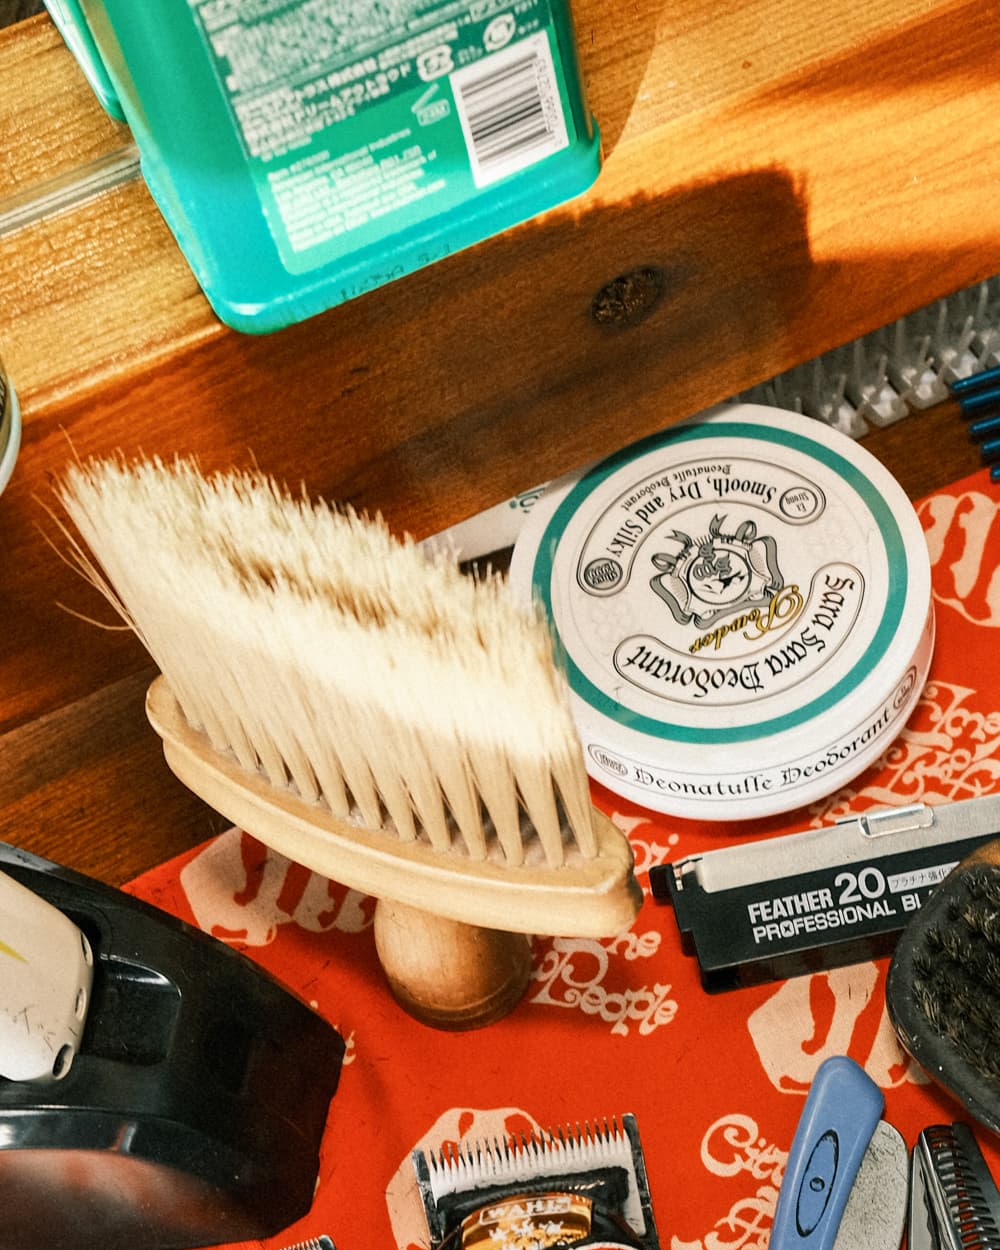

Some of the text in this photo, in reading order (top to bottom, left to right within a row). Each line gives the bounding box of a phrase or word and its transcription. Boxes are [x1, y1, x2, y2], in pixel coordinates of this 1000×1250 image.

[605, 476, 777, 558] Smooth, Dry and Silky
[622, 574, 856, 699] Sara Sara Deodorant
[687, 584, 805, 656] Powder
[780, 708, 893, 786] Deodorant
[748, 866, 886, 925] FEATHER 20
[752, 898, 897, 944] PROFESSIONAL
[530, 937, 679, 1038] People
